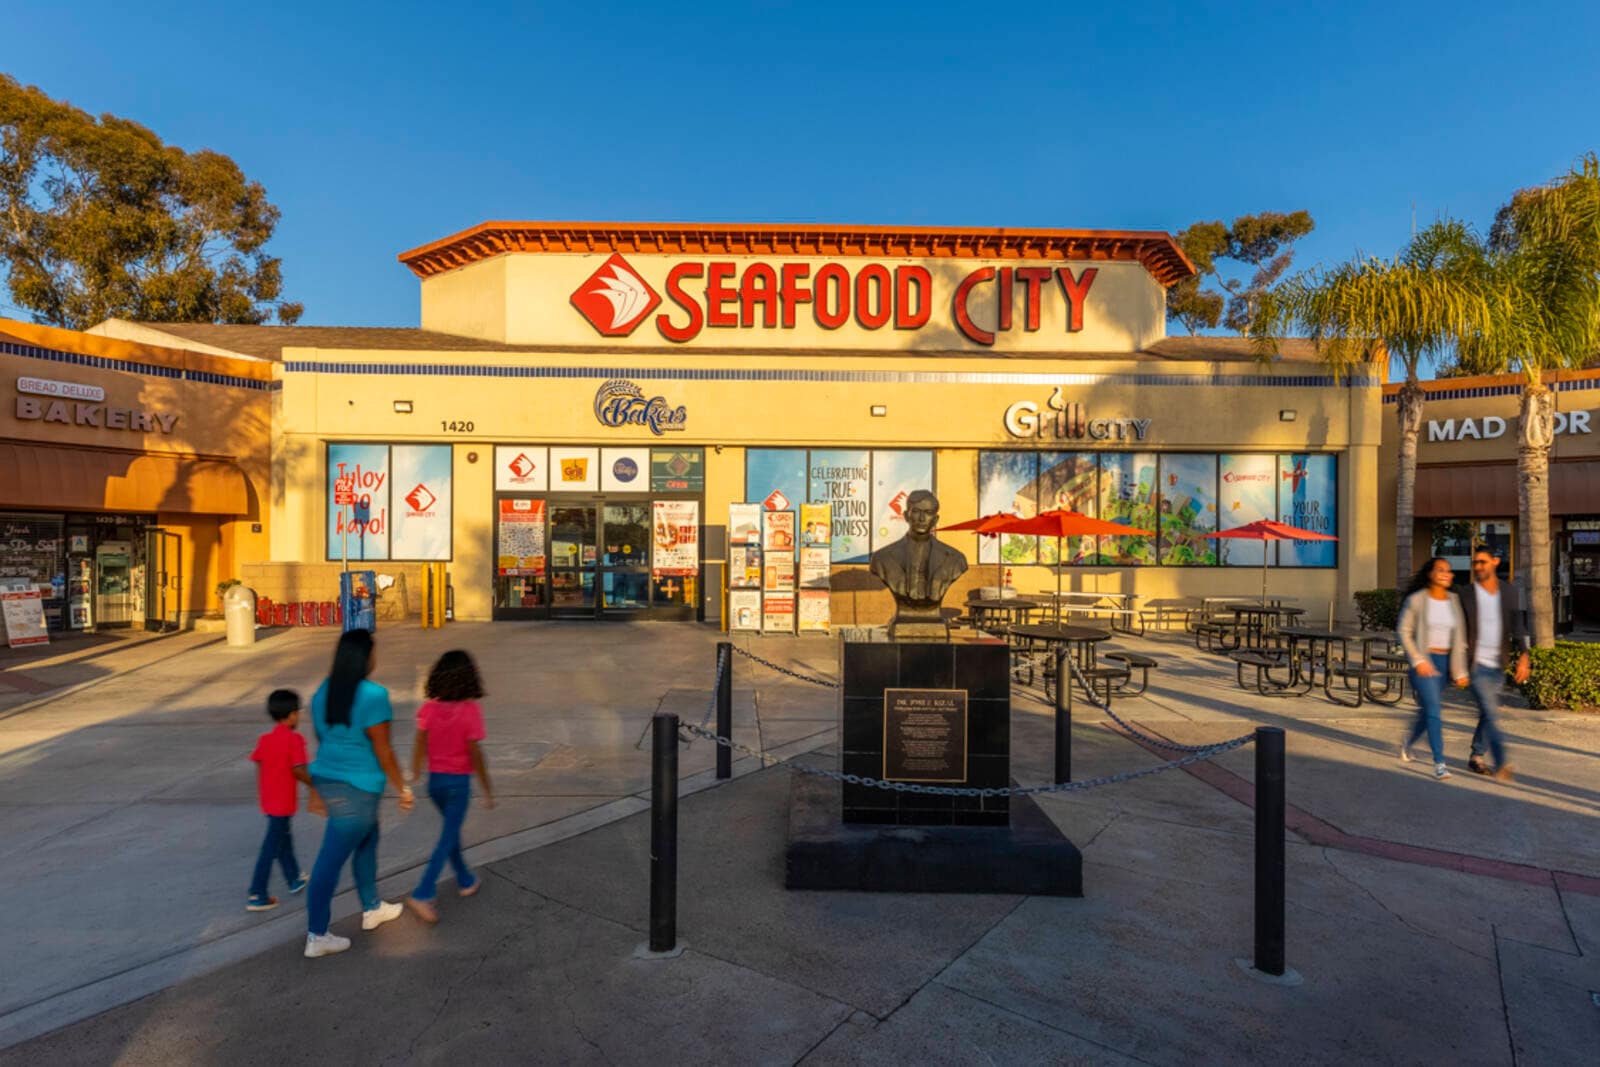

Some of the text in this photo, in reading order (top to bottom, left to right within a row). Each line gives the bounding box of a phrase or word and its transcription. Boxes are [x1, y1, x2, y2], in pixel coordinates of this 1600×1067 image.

[656, 262, 1098, 345] SEAFOOD CITY
[20, 378, 102, 399] BREAD DELUXE
[16, 396, 178, 434] BAKERY
[1004, 387, 1151, 440] Grill CITY
[441, 420, 475, 432] 1420
[1428, 410, 1592, 442] MAD OR
[811, 467, 867, 480] CELEBRATING
[825, 481, 853, 498] TRUE
[1293, 501, 1320, 515] YOUR
